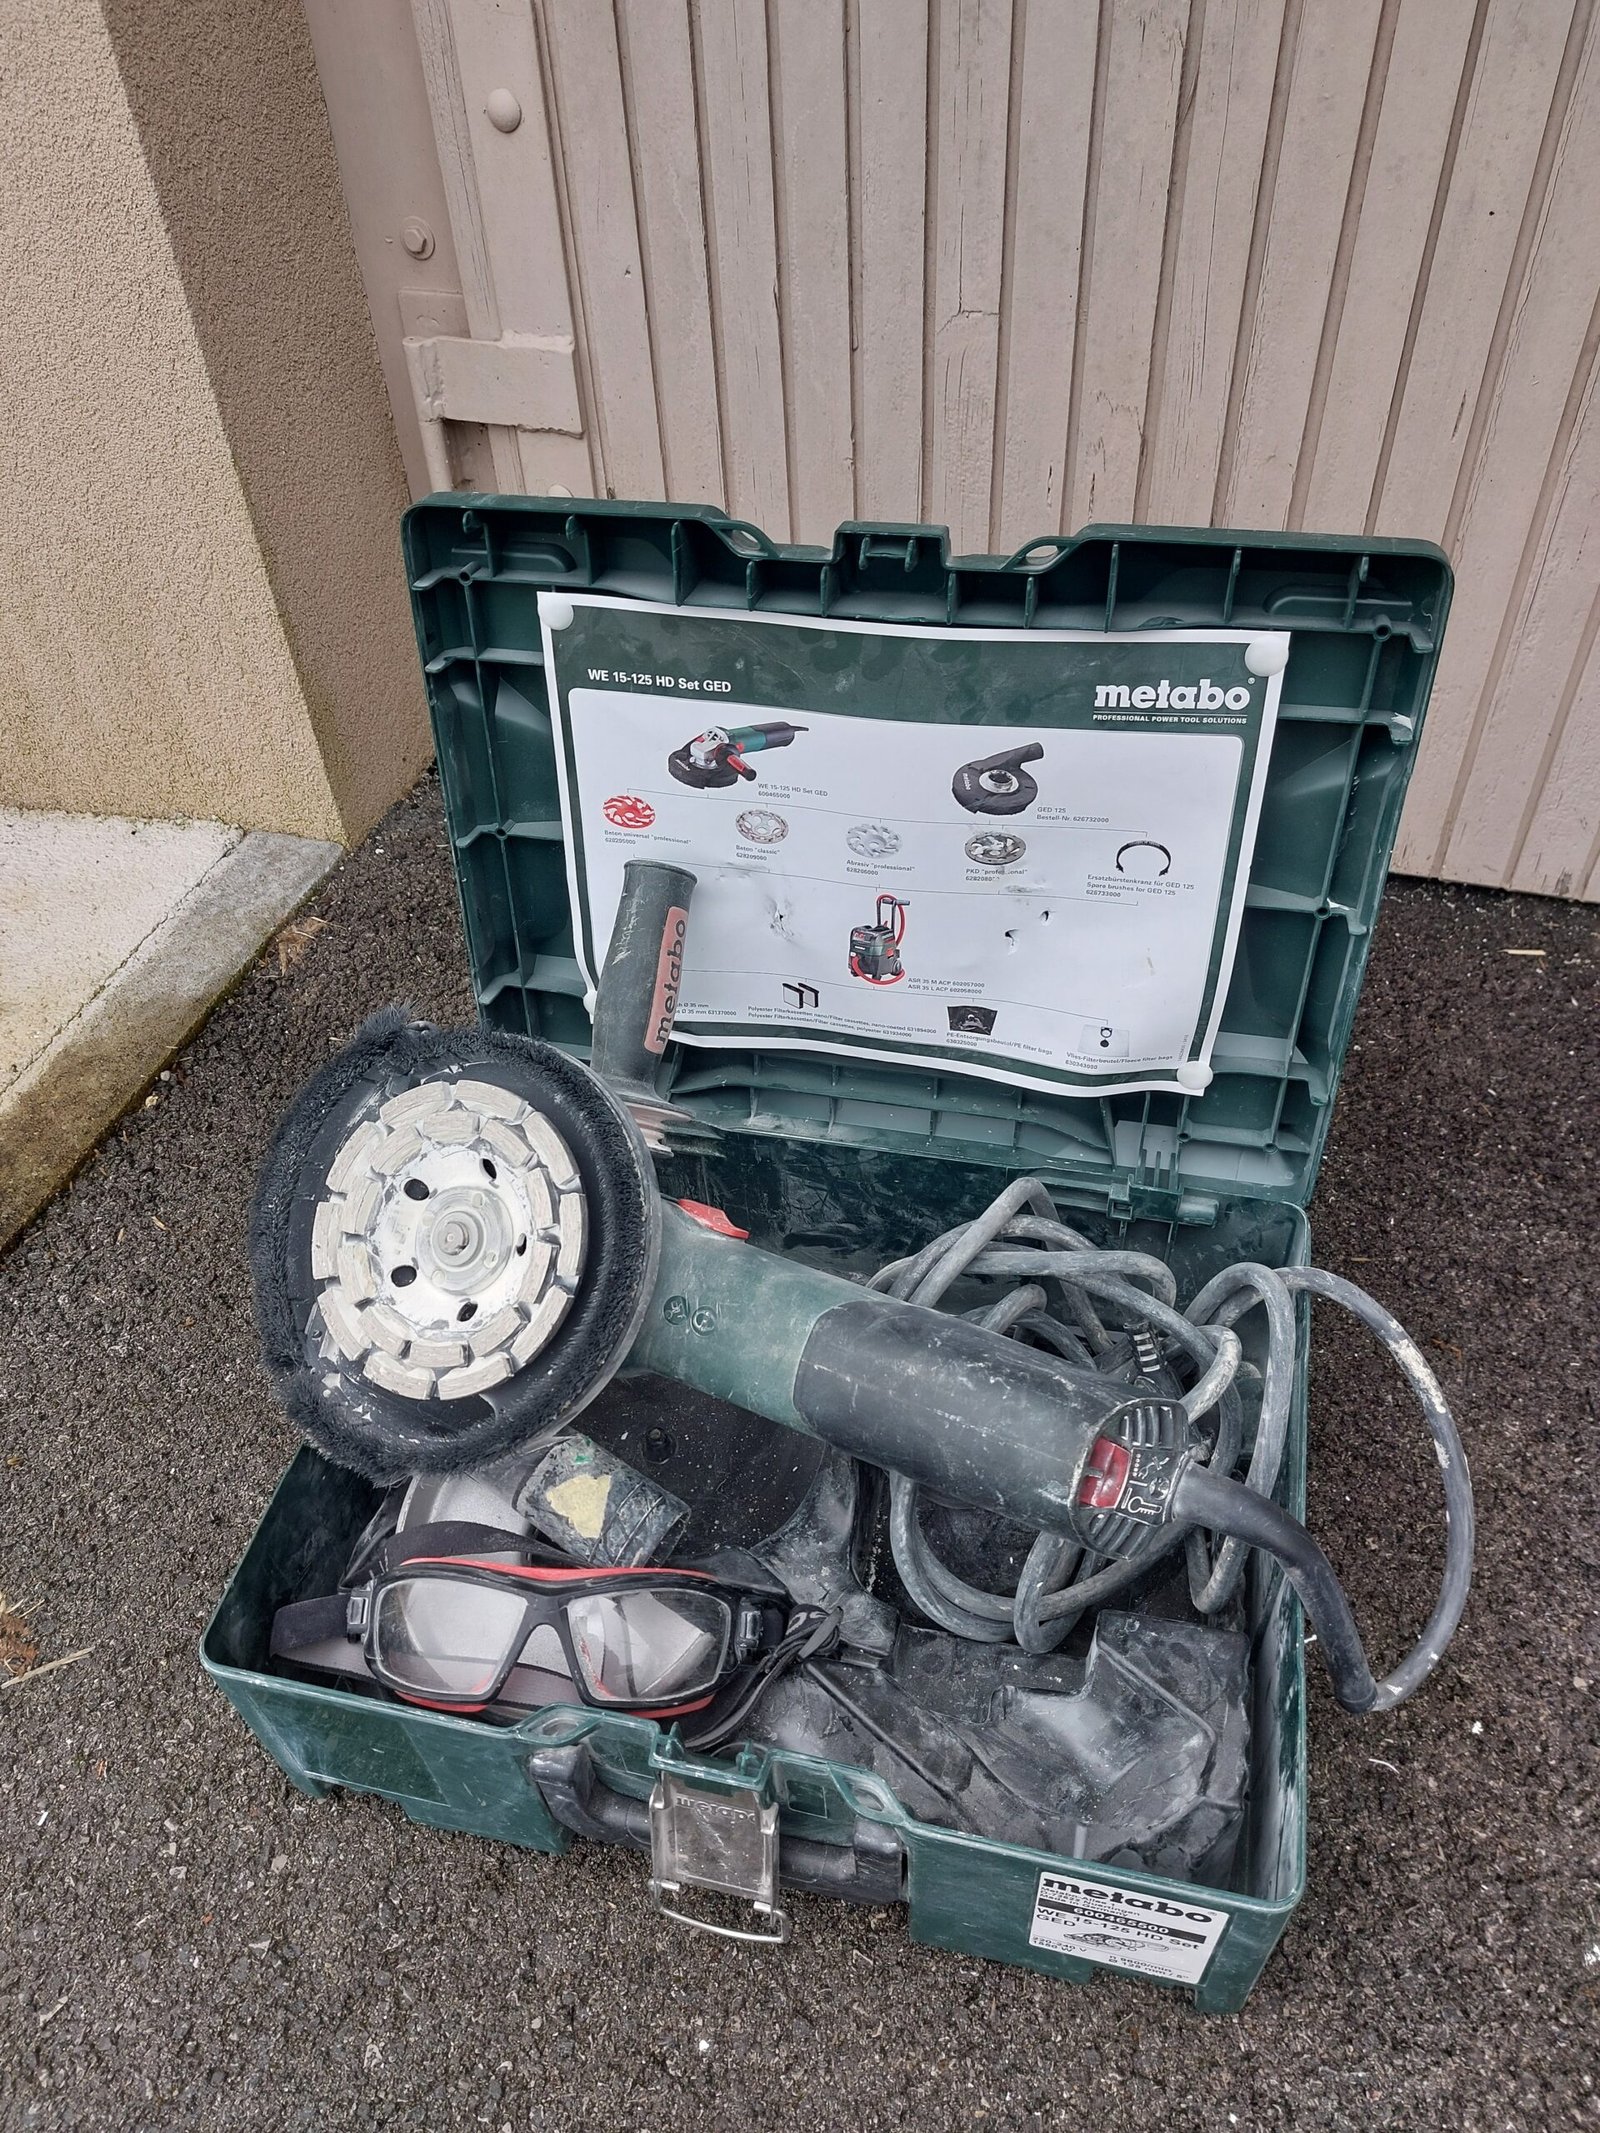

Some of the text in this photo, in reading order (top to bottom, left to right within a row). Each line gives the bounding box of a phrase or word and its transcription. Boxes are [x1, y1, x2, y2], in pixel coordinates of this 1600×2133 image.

[588, 669, 731, 692] WE 15-125 HD Set GED
[1094, 679, 1250, 710] metabo
[1093, 714, 1150, 722] PROFESSIONAL
[1151, 715, 1179, 723] POWER
[656, 919, 686, 1044] metabo
[1043, 1878, 1212, 1923] metabo
[1037, 1914, 1075, 1927] GED
[1037, 1907, 1200, 1950] WE 15-125 HD Set
